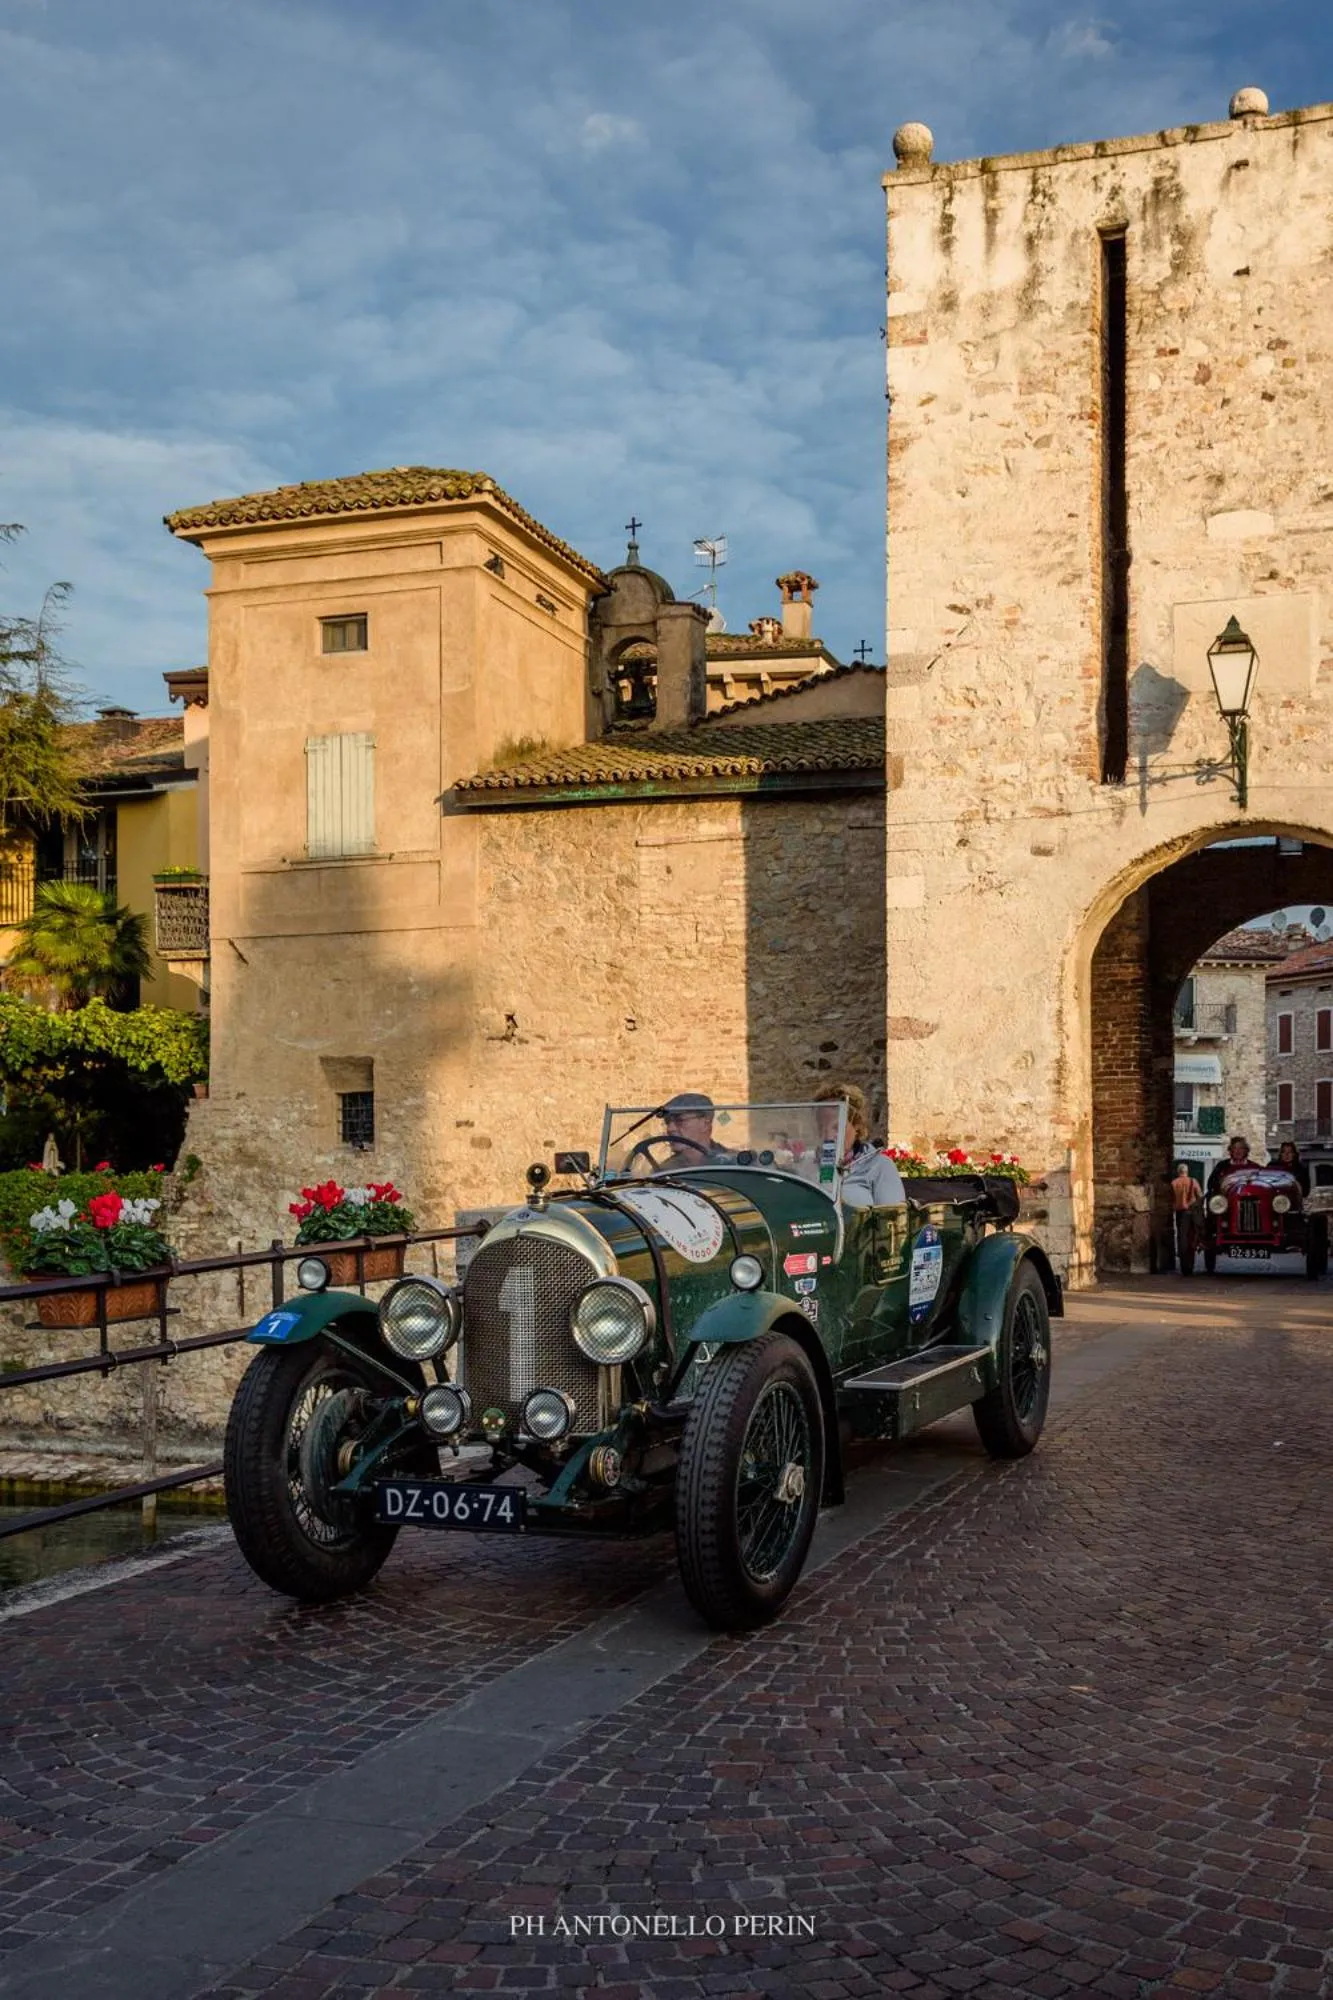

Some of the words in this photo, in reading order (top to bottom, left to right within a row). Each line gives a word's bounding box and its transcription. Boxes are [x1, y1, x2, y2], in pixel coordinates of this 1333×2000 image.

[268, 1320, 281, 1335] 1
[499, 1266, 536, 1402] 1
[386, 1488, 514, 1523] DZ-06-74
